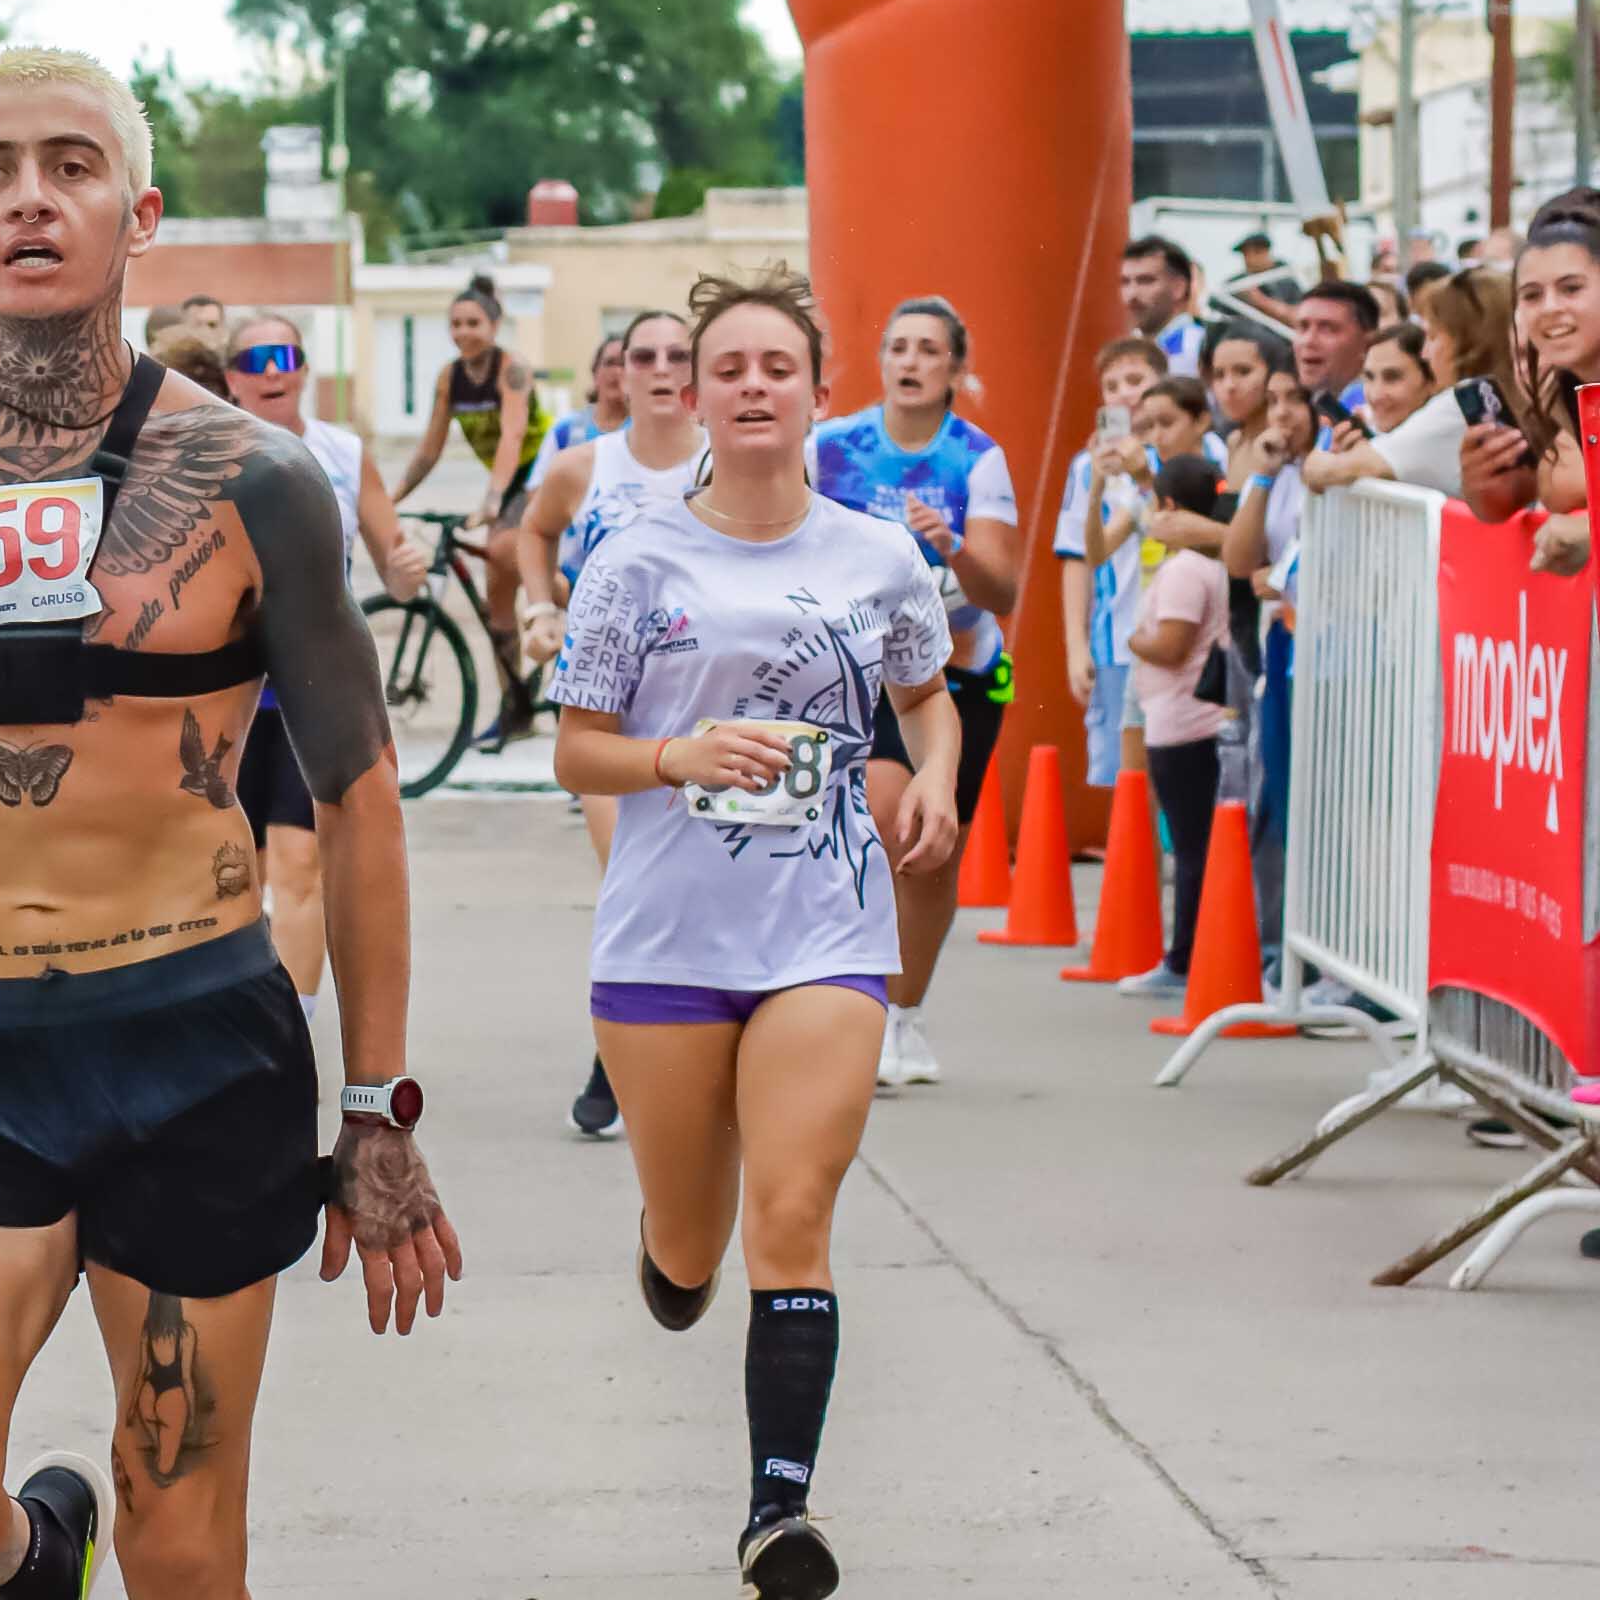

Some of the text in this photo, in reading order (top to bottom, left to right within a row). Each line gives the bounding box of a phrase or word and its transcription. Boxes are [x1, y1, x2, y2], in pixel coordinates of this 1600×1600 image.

[31, 592, 85, 608] CARUSO
[780, 626, 803, 649] 345
[1453, 589, 1567, 810] moplex
[772, 1297, 830, 1312] SOX
